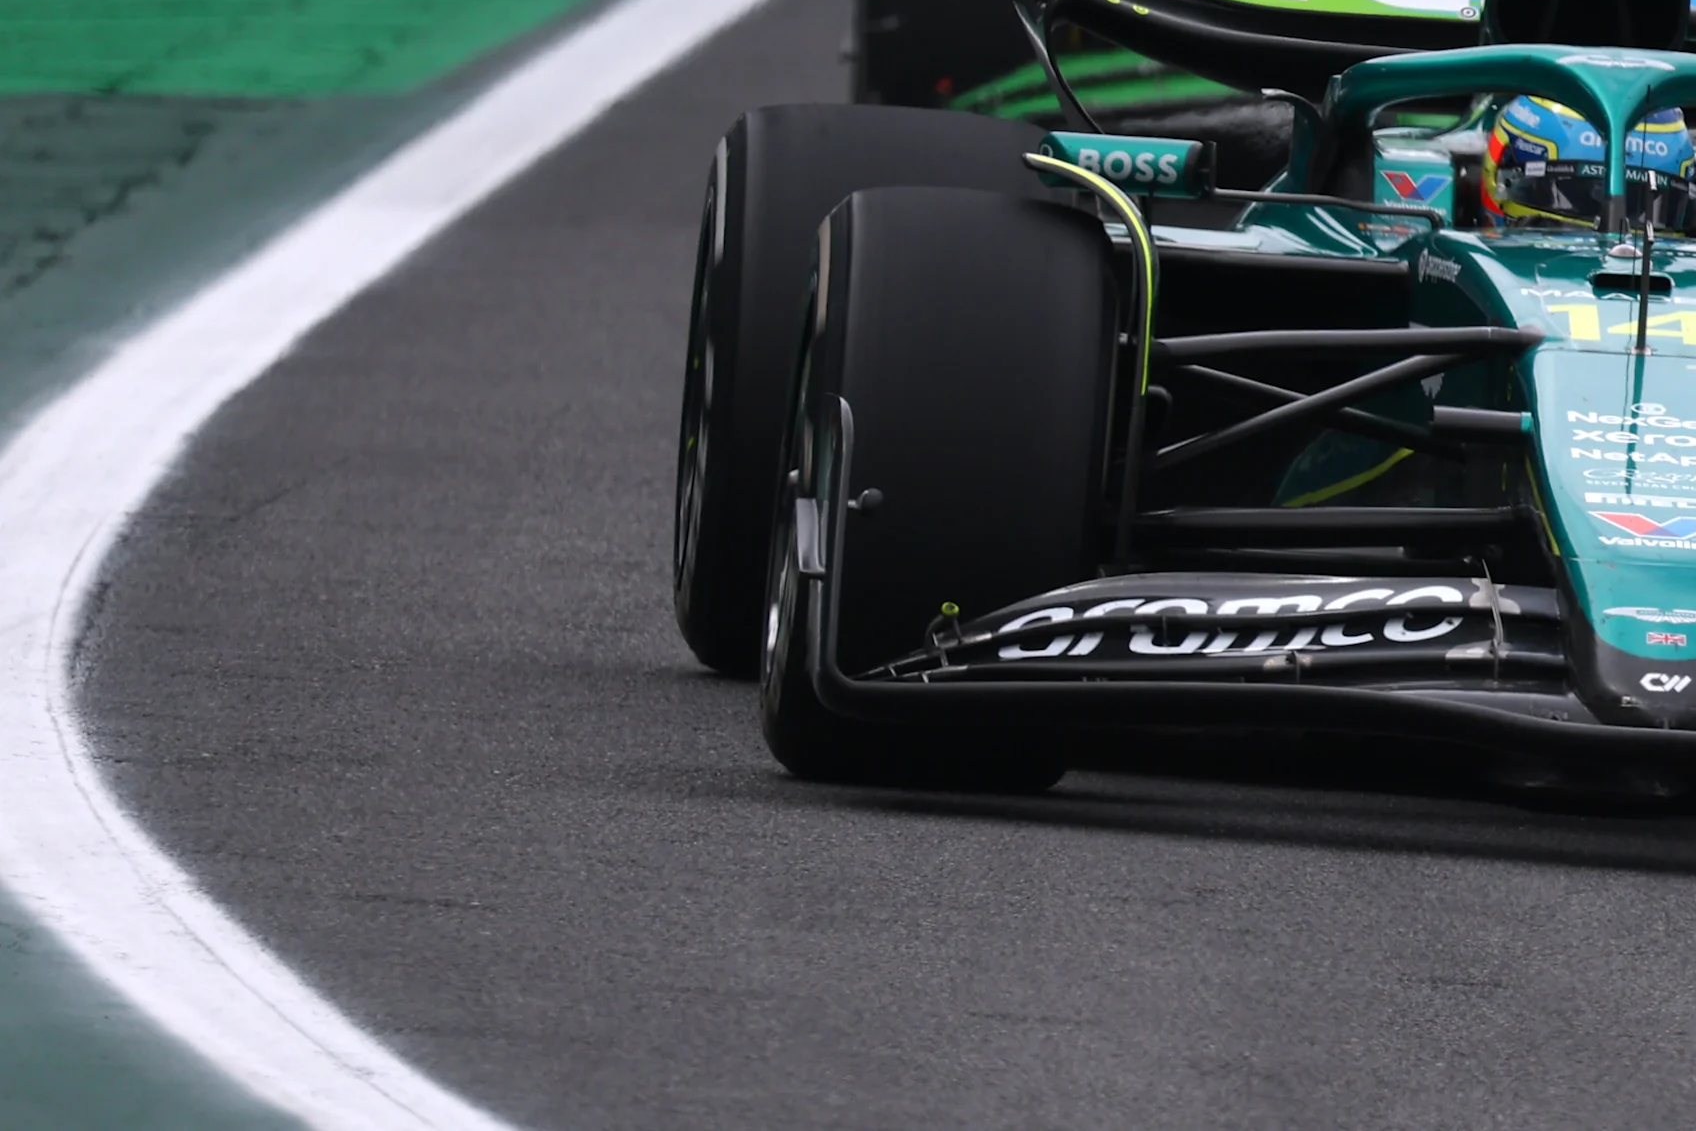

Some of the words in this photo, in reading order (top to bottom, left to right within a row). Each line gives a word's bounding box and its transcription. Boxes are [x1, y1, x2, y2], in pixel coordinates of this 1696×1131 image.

[1580, 131, 1668, 156] armco
[1078, 148, 1178, 184] BOSS
[997, 585, 1464, 659] aramco
